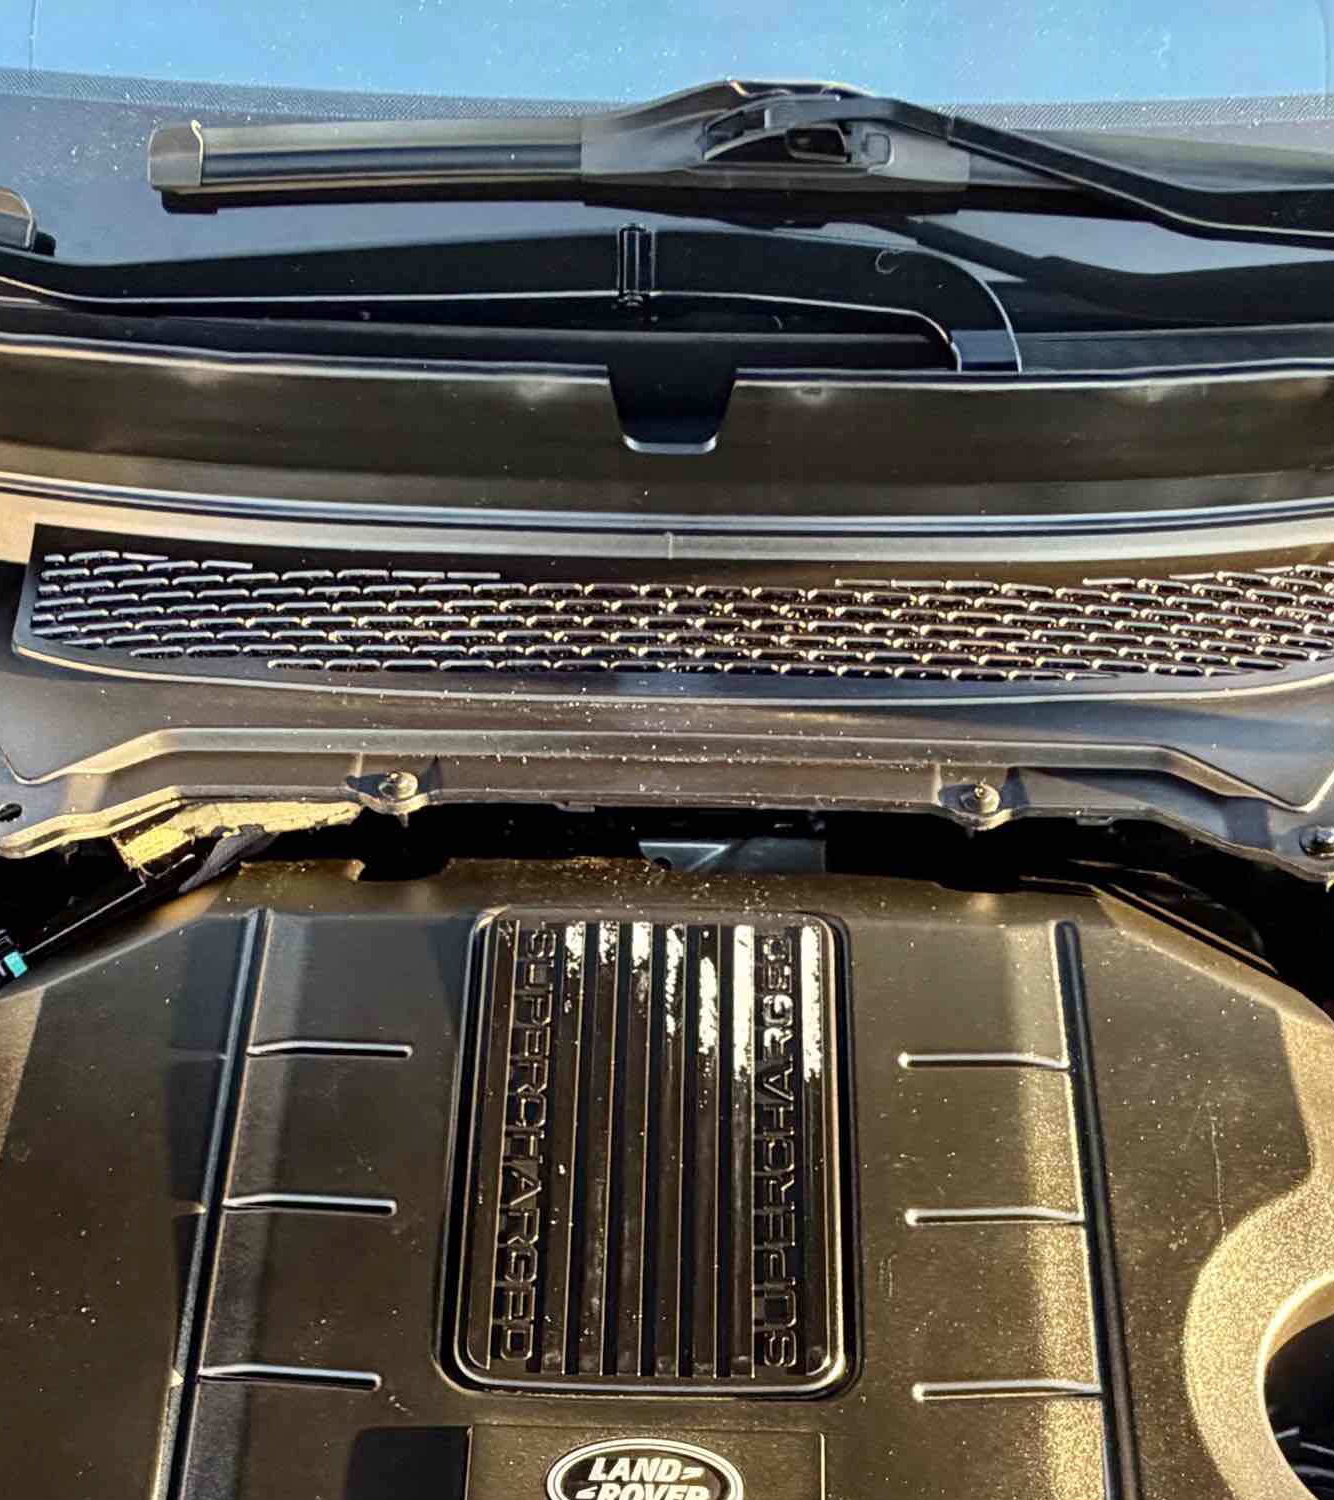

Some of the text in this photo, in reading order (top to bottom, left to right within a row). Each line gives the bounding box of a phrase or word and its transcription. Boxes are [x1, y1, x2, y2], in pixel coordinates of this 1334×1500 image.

[499, 927, 557, 1363] SUPERCHARGED
[758, 933, 798, 1369] SUPERCHARGED
[587, 1456, 682, 1482] LAND
